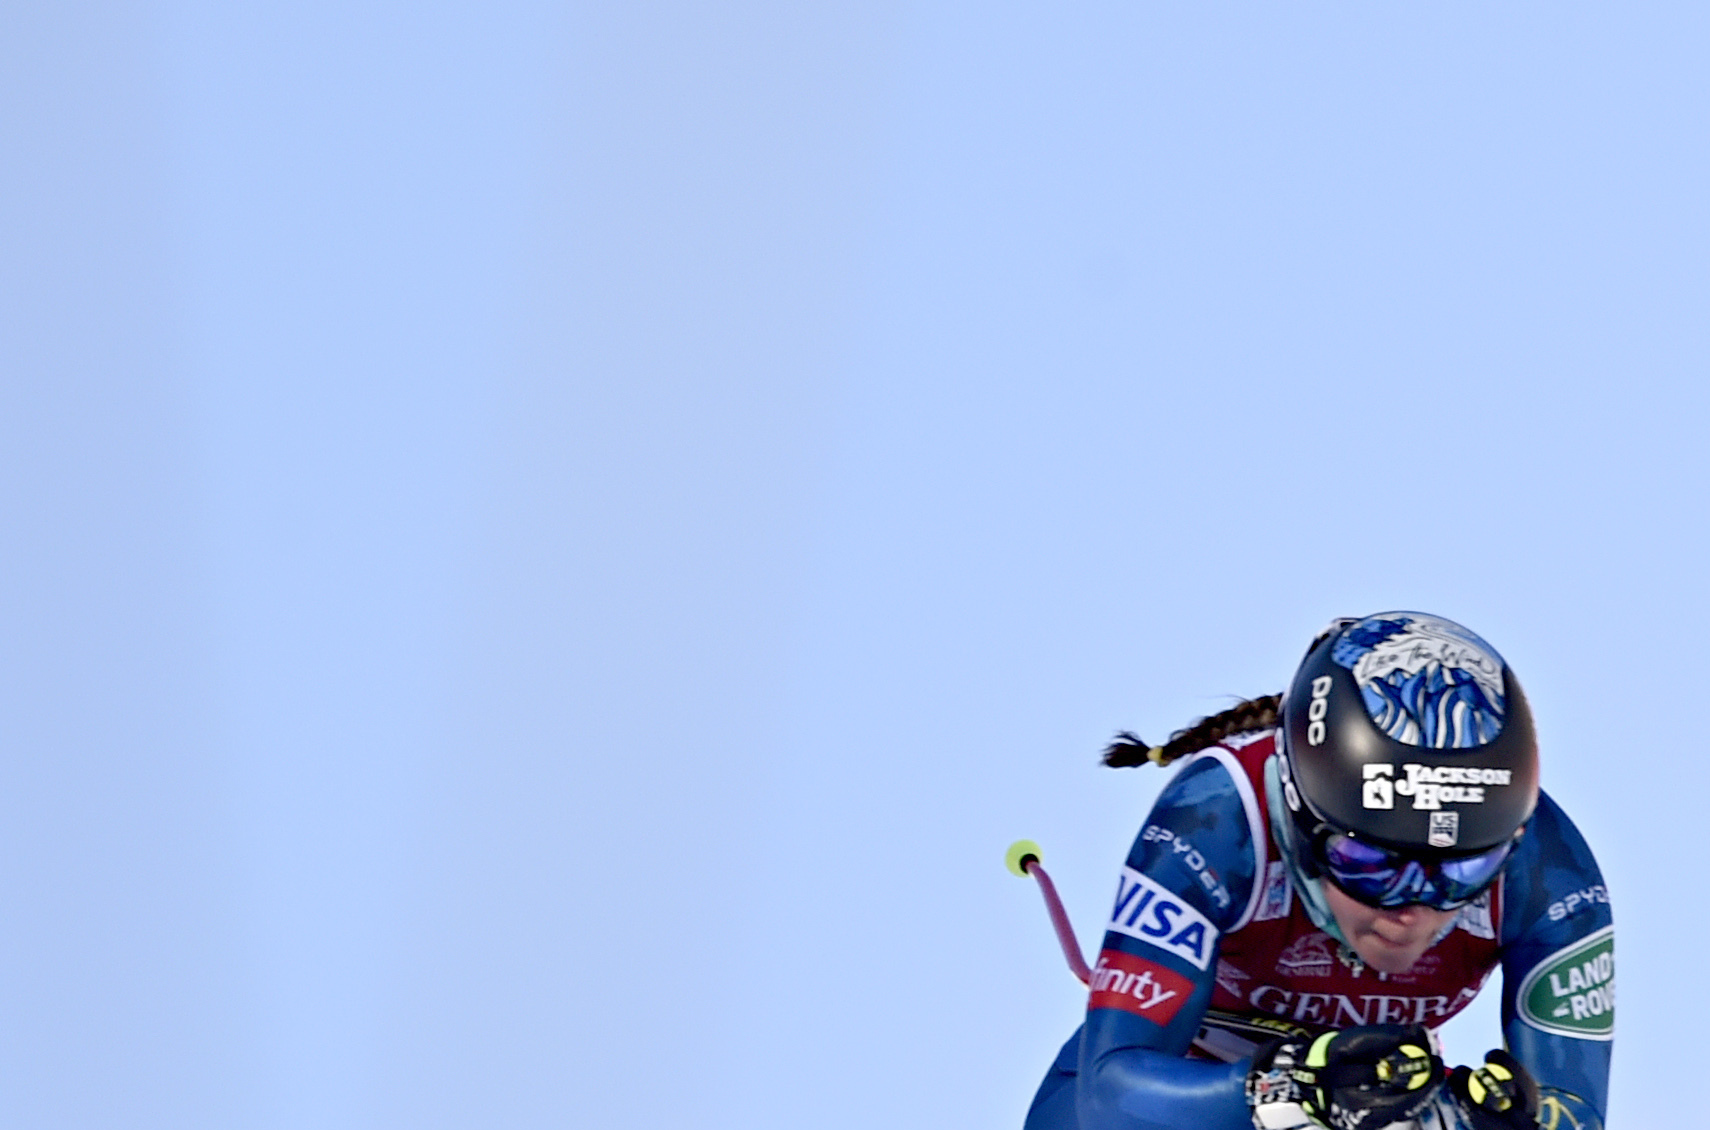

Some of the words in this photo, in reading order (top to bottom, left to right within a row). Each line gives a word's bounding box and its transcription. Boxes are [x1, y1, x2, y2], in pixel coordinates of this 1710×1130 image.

[1142, 825, 1231, 909] SPYDER
[1112, 875, 1206, 961] VISA
[1548, 885, 1611, 921] SPYD
[1550, 951, 1613, 998] LAND
[1248, 984, 1480, 1029] GENERA
[1570, 980, 1616, 1021] ROV
